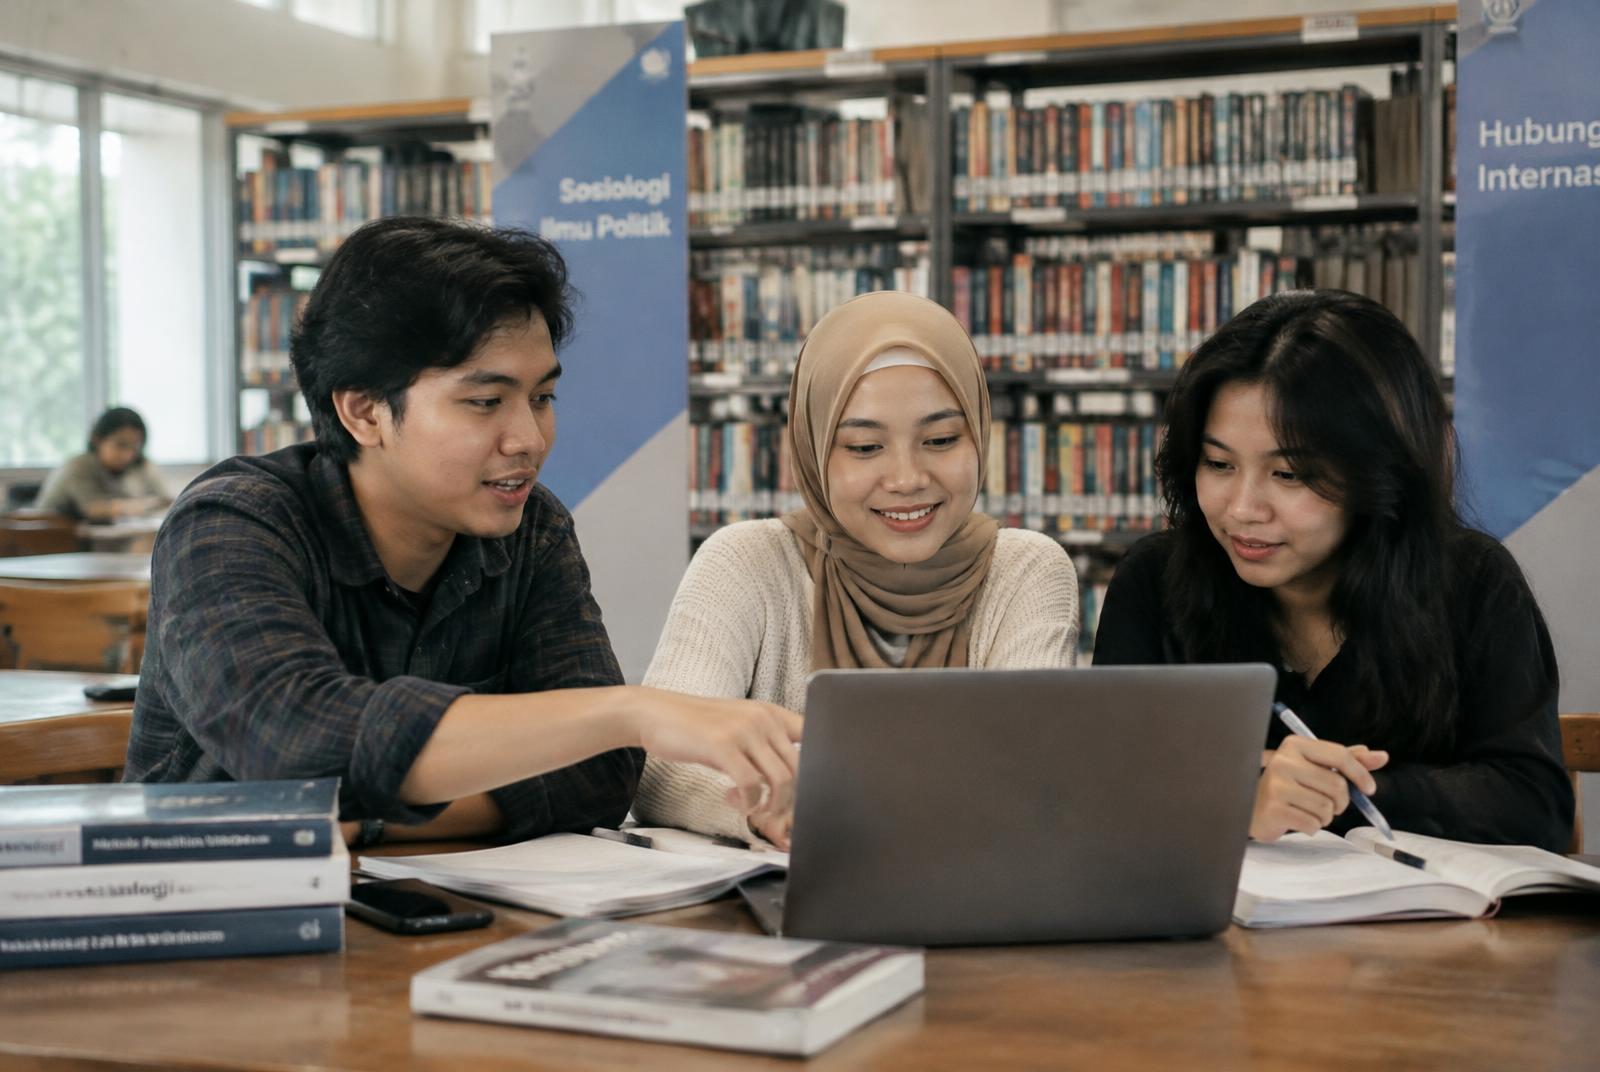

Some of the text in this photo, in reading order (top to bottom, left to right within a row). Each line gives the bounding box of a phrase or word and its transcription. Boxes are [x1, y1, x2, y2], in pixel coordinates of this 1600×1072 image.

[1479, 117, 1600, 148] Hubung
[560, 172, 671, 206] Sosiologi
[597, 210, 671, 239] Politik
